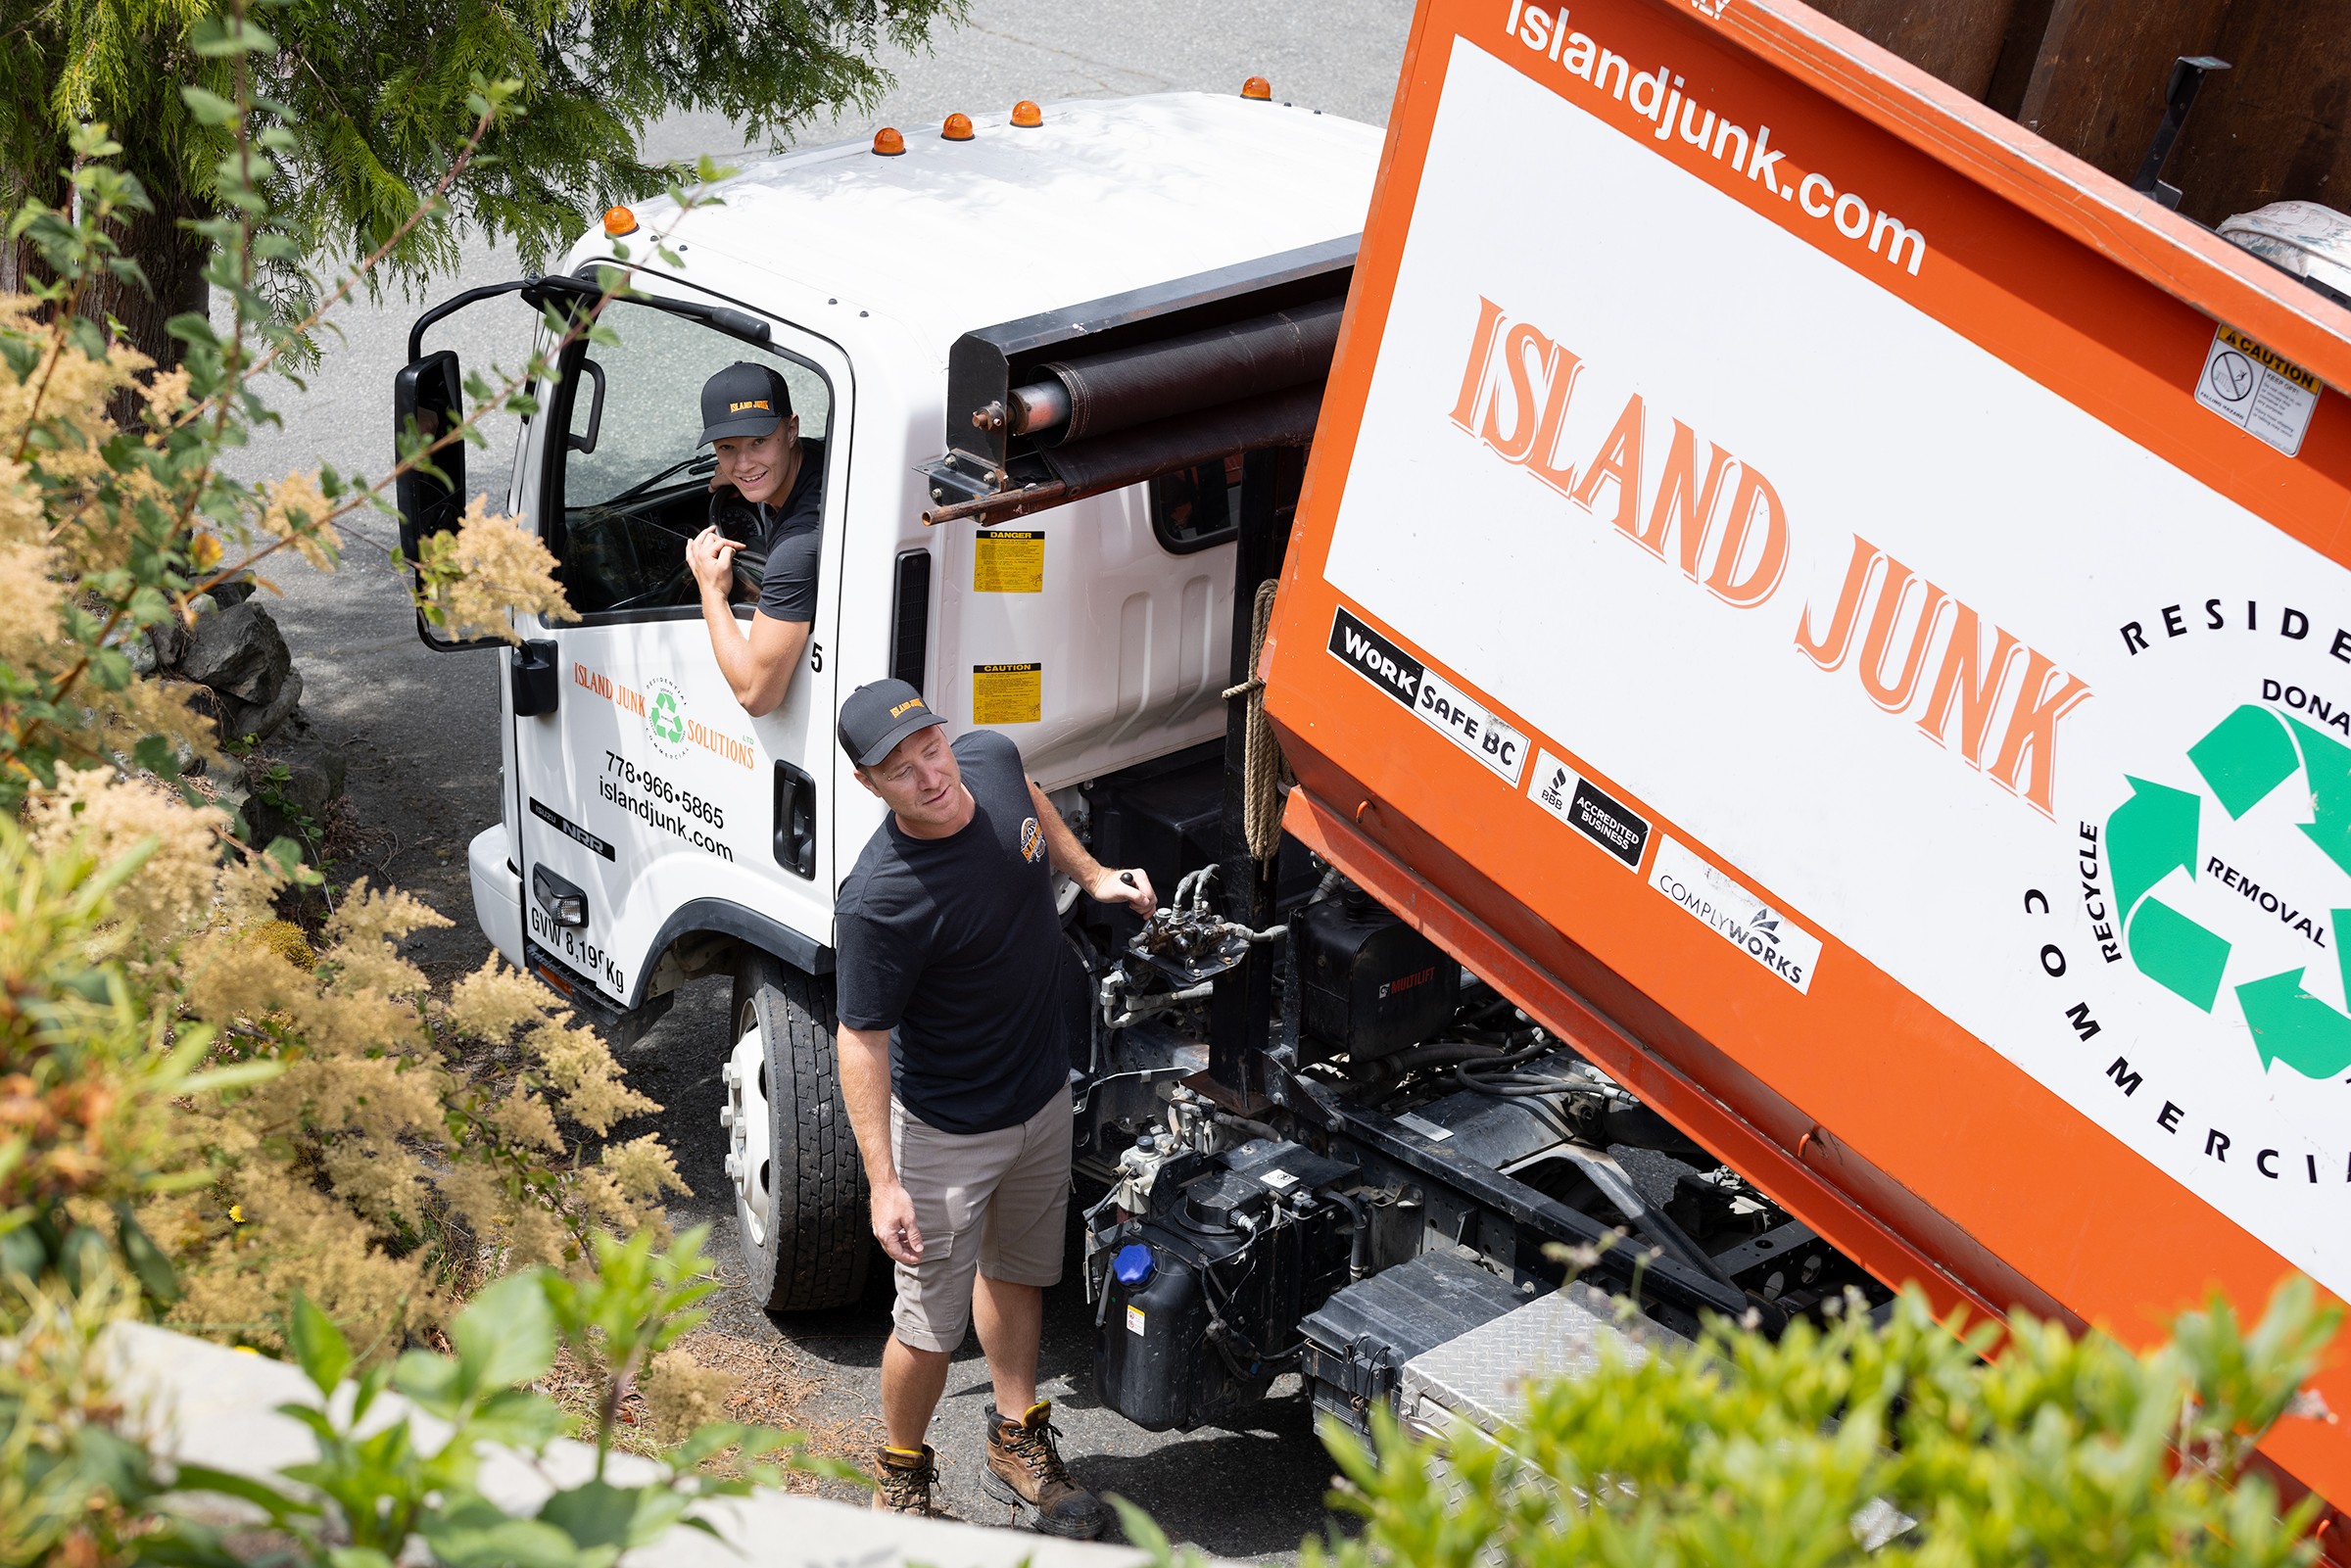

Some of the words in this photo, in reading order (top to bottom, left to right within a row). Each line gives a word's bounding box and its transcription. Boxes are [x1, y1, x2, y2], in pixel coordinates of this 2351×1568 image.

[2239, 337, 2314, 389] CAUTION
[730, 401, 753, 414] ISLAND
[1448, 294, 1790, 609] ISLAND
[1793, 532, 2094, 825] JUNK
[810, 641, 823, 674] 5
[2120, 598, 2351, 665] RESIDE
[574, 662, 613, 700] ISLAND
[616, 685, 647, 718] JUNK
[1344, 625, 1417, 698] WORK
[1420, 685, 1479, 739] SAFE
[1481, 731, 1516, 767] BC
[2262, 678, 2351, 736] DONA
[688, 719, 754, 771] SOLUTIONS
[743, 735, 754, 745] LTD
[599, 775, 734, 863] islandjunk.com
[1541, 788, 1563, 811] BBB
[1576, 796, 1640, 844] ACCREDITED
[536, 805, 556, 824] ISUZU
[562, 820, 604, 854] NRR
[1581, 810, 1630, 850] BUSINESS
[2079, 821, 2123, 964] RECYCLE
[2206, 856, 2327, 948] REMOVAL
[532, 907, 561, 947] GVW
[606, 958, 624, 994] Kg
[1659, 875, 1802, 984] COMPLYWORKS
[1391, 967, 1435, 994] MULTILIFT
[2024, 888, 2351, 1184] COMMERCI
